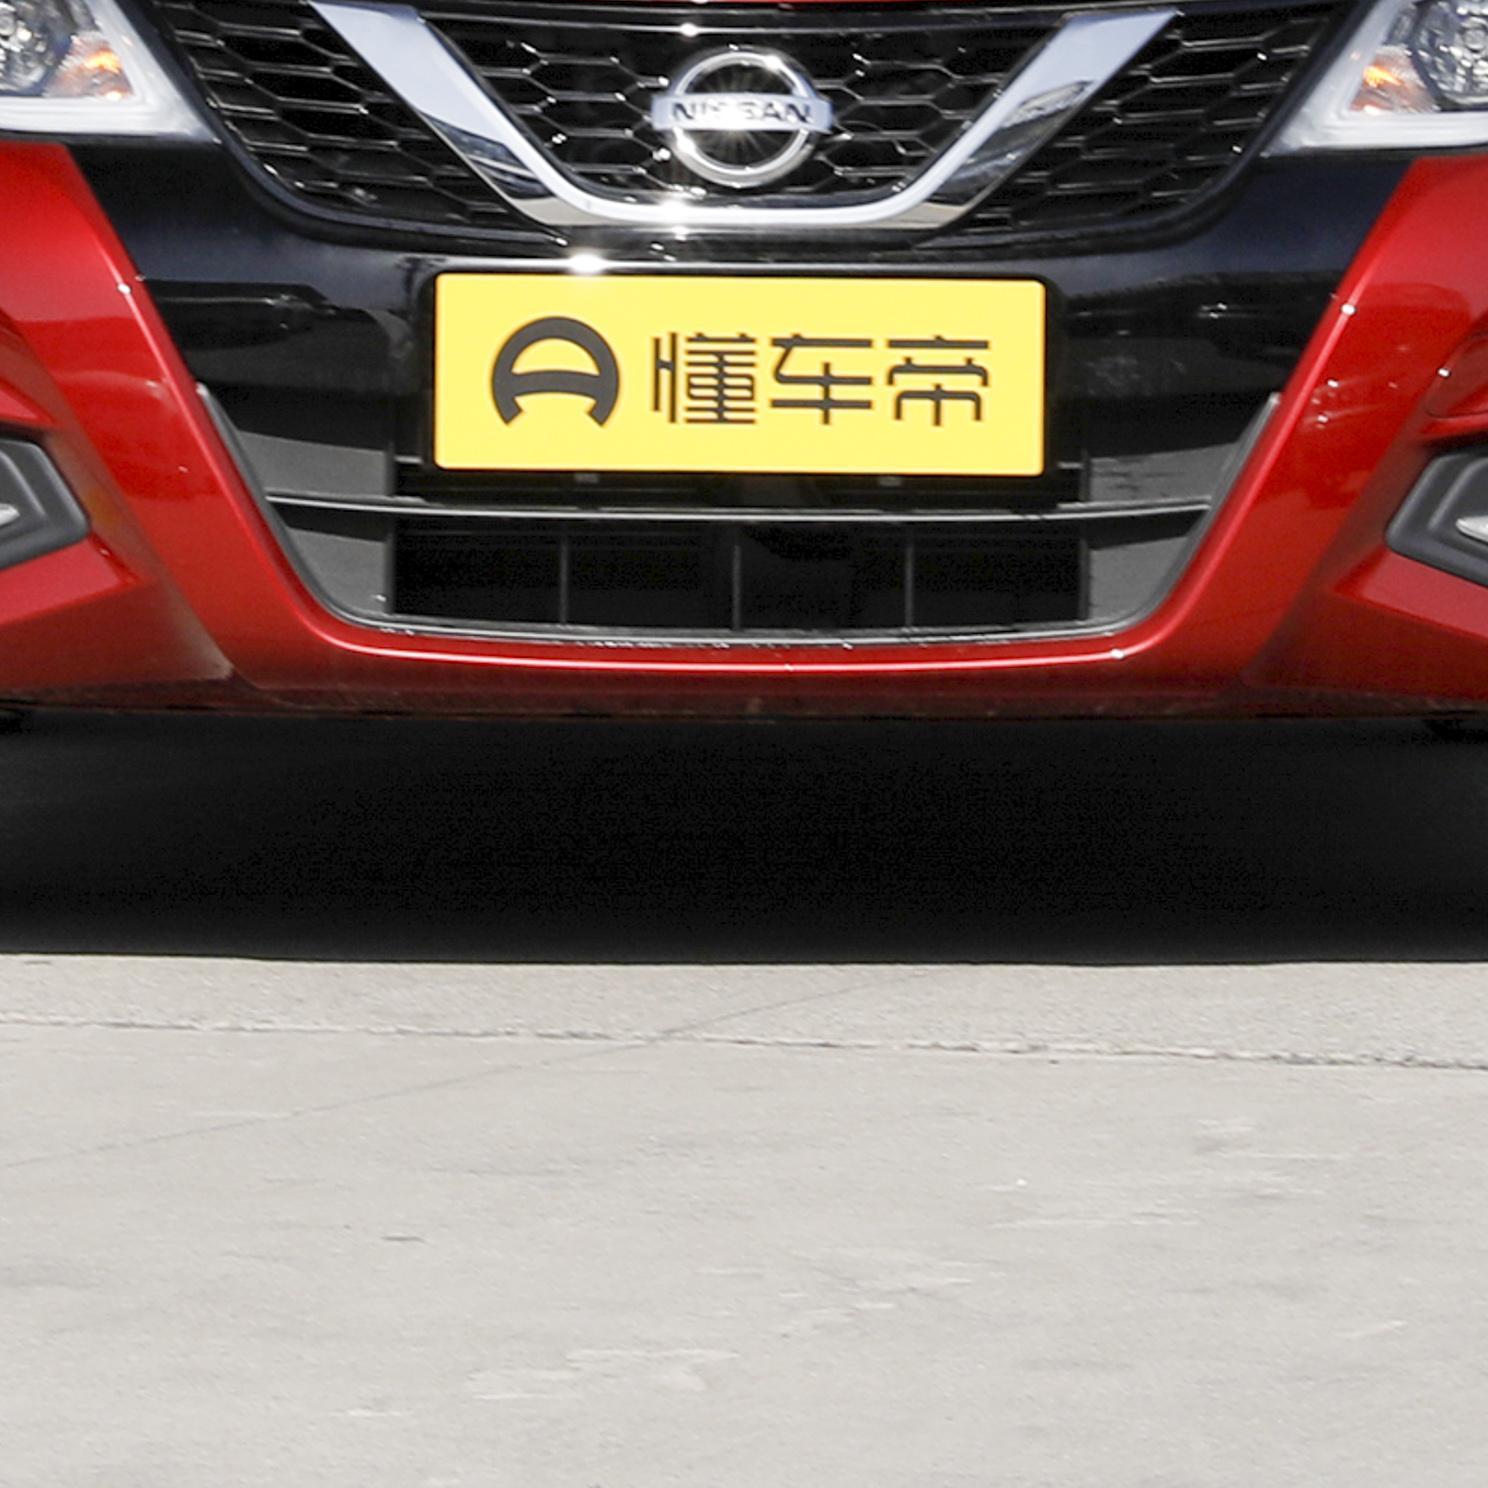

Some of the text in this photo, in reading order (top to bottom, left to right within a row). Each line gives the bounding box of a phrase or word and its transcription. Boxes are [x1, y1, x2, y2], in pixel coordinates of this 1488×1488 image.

[670, 100, 815, 125] NISSAN
[652, 330, 992, 428] 懂车帝
